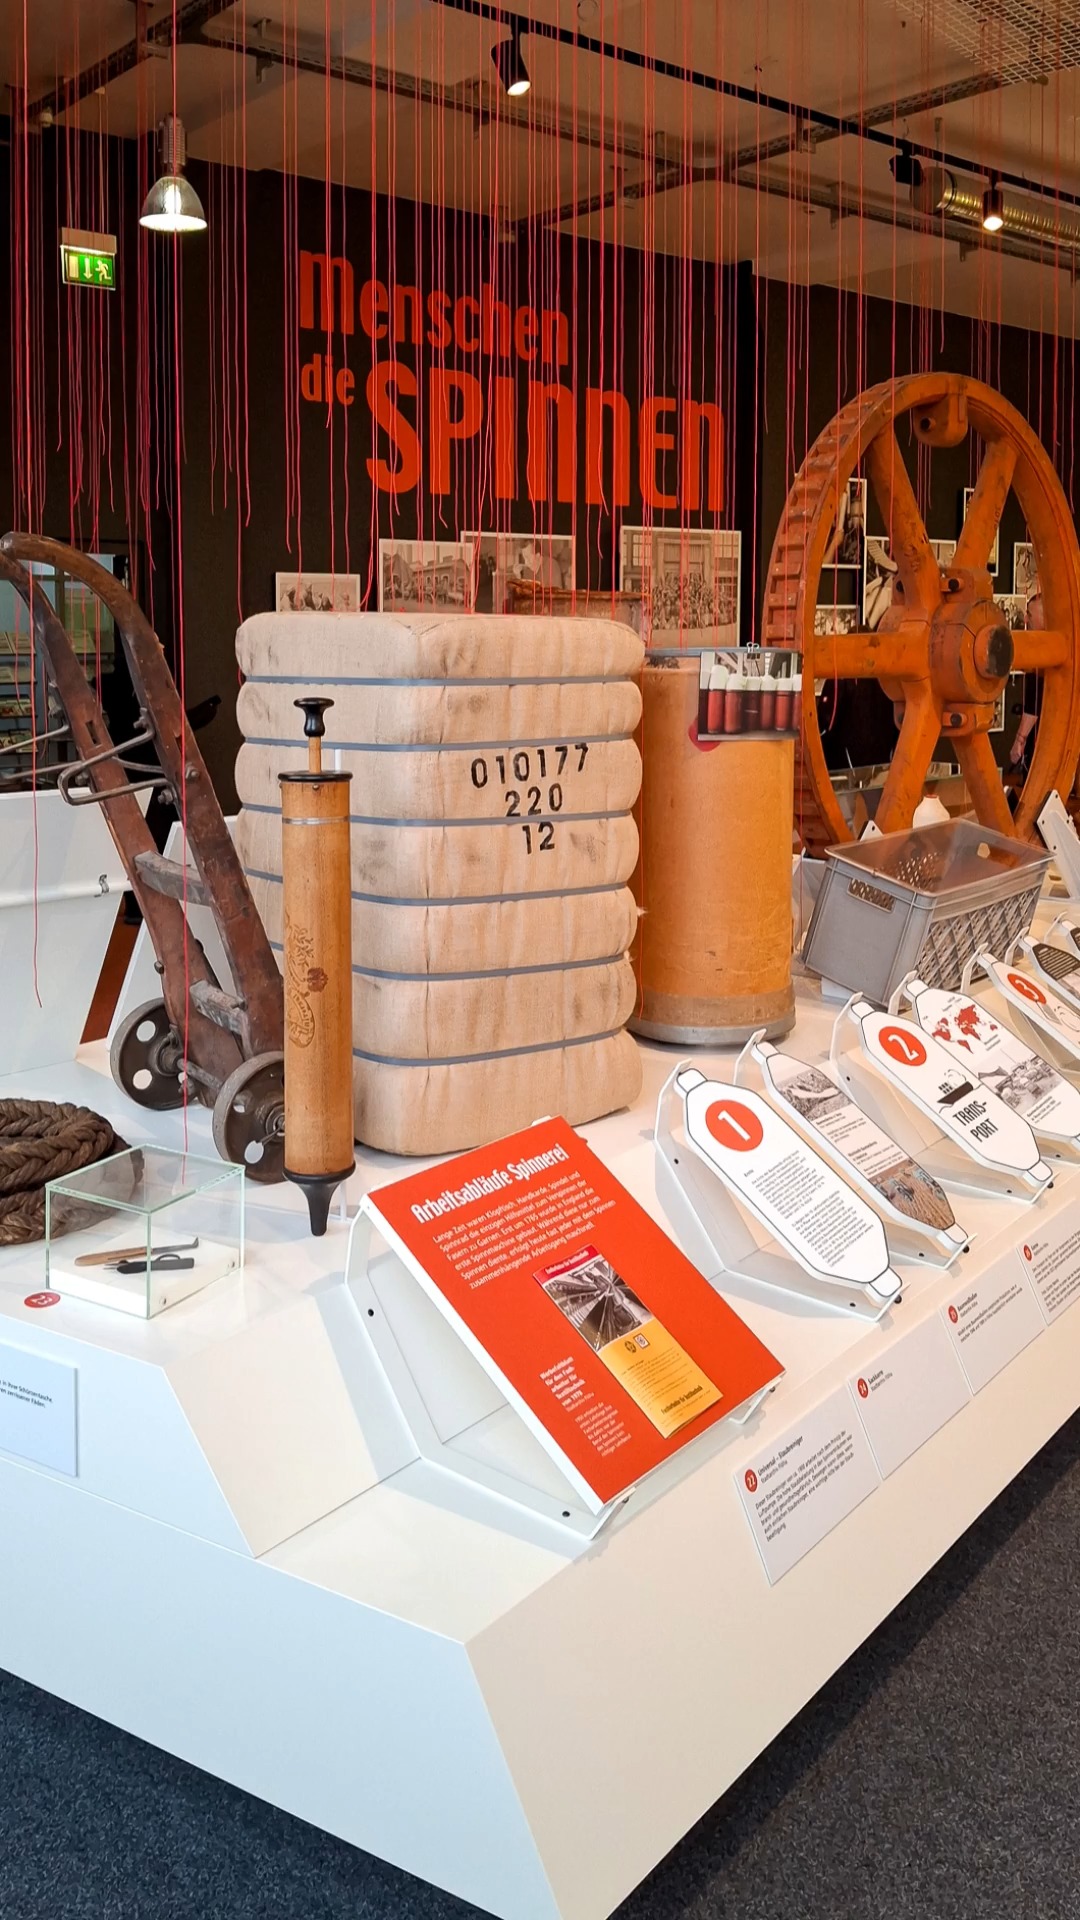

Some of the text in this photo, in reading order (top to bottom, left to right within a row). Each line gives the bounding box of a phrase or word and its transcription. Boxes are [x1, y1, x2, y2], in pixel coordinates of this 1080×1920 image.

[301, 353, 355, 406] die
[470, 742, 589, 789] 010177
[505, 783, 563, 817] 220
[522, 821, 555, 855] 12
[888, 1033, 920, 1061] 2
[717, 1109, 751, 1141] 1
[970, 1117, 999, 1143] PORT
[409, 1142, 570, 1224] Arbeitsabläufe Spinnerei
[431, 1230, 454, 1243] Lange
[451, 1223, 467, 1234] Zeit
[465, 1215, 487, 1228] waren
[568, 1170, 581, 1180] und
[438, 1233, 469, 1252] Spinnrad
[467, 1230, 480, 1238] die
[478, 1218, 506, 1233] einzigen
[534, 1197, 548, 1207] zum
[574, 1179, 587, 1187] der
[445, 1247, 470, 1261] Fasern
[468, 1243, 478, 1251] zu
[500, 1224, 514, 1235] Erst
[513, 1221, 525, 1229] um
[537, 1205, 557, 1217] wurde
[582, 1187, 595, 1195] die
[454, 1259, 472, 1271] erste
[469, 1237, 516, 1263] Spinnmaschine
[577, 1201, 589, 1210] nur
[460, 1263, 488, 1279] Spinnen
[528, 1233, 548, 1246] heute
[571, 1214, 583, 1224] mit
[580, 1210, 596, 1219] dem
